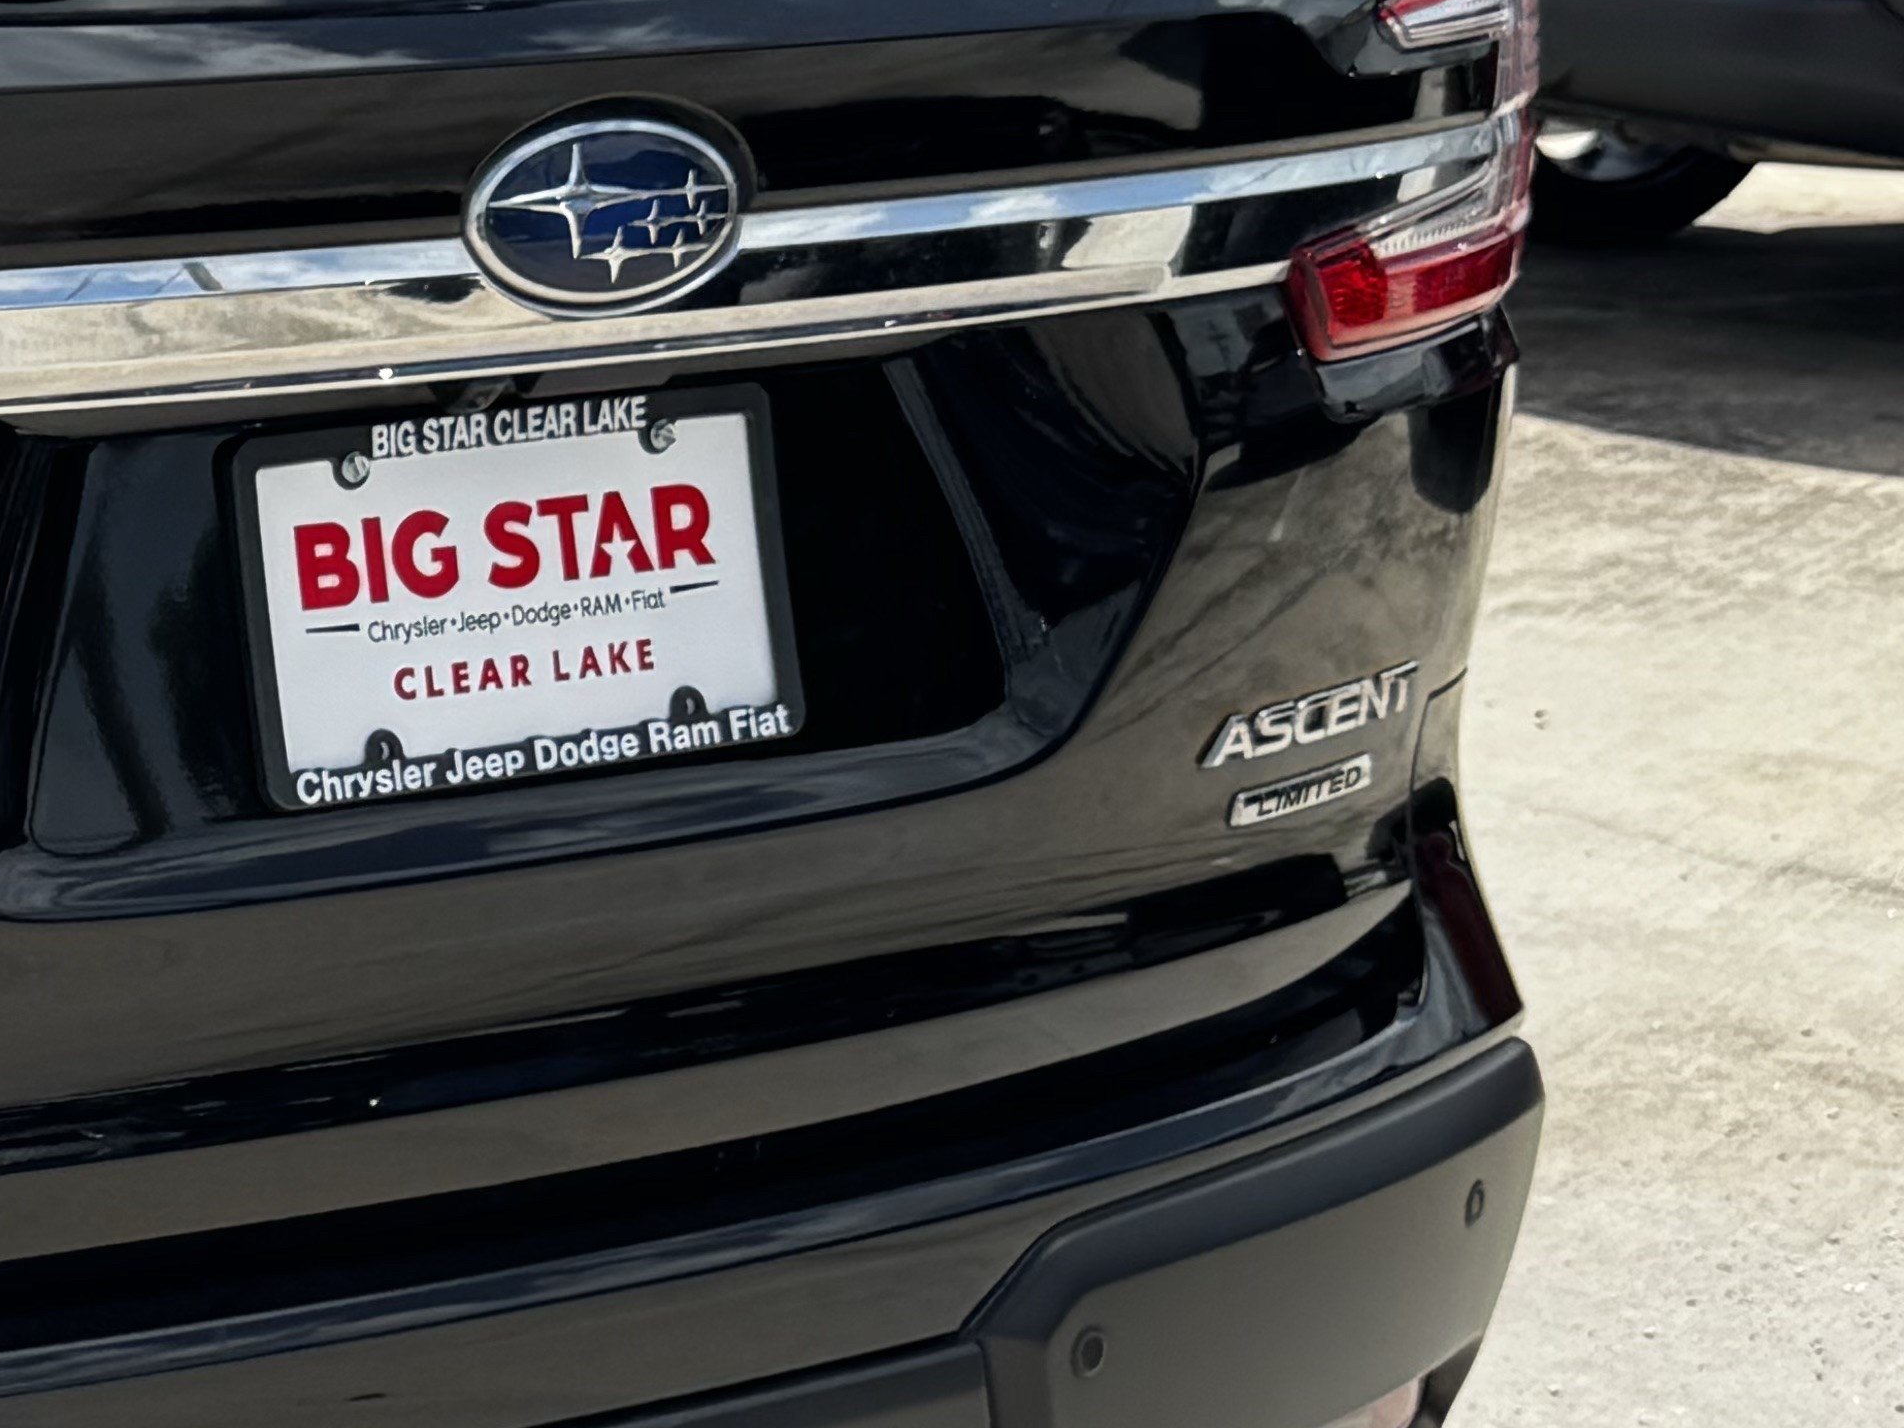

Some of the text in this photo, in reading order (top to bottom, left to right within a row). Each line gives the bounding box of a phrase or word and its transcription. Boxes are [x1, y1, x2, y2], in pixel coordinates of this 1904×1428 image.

[372, 395, 647, 458] BIG STAR CLEAR LAKE
[293, 484, 716, 611] BIG STAR
[393, 638, 655, 701] CLEAR LAKE
[296, 704, 791, 806] Chrysler Jeep Dodge Ram Fiat
[1199, 660, 1420, 769] ASCENT
[1256, 766, 1362, 816] LIMITED
